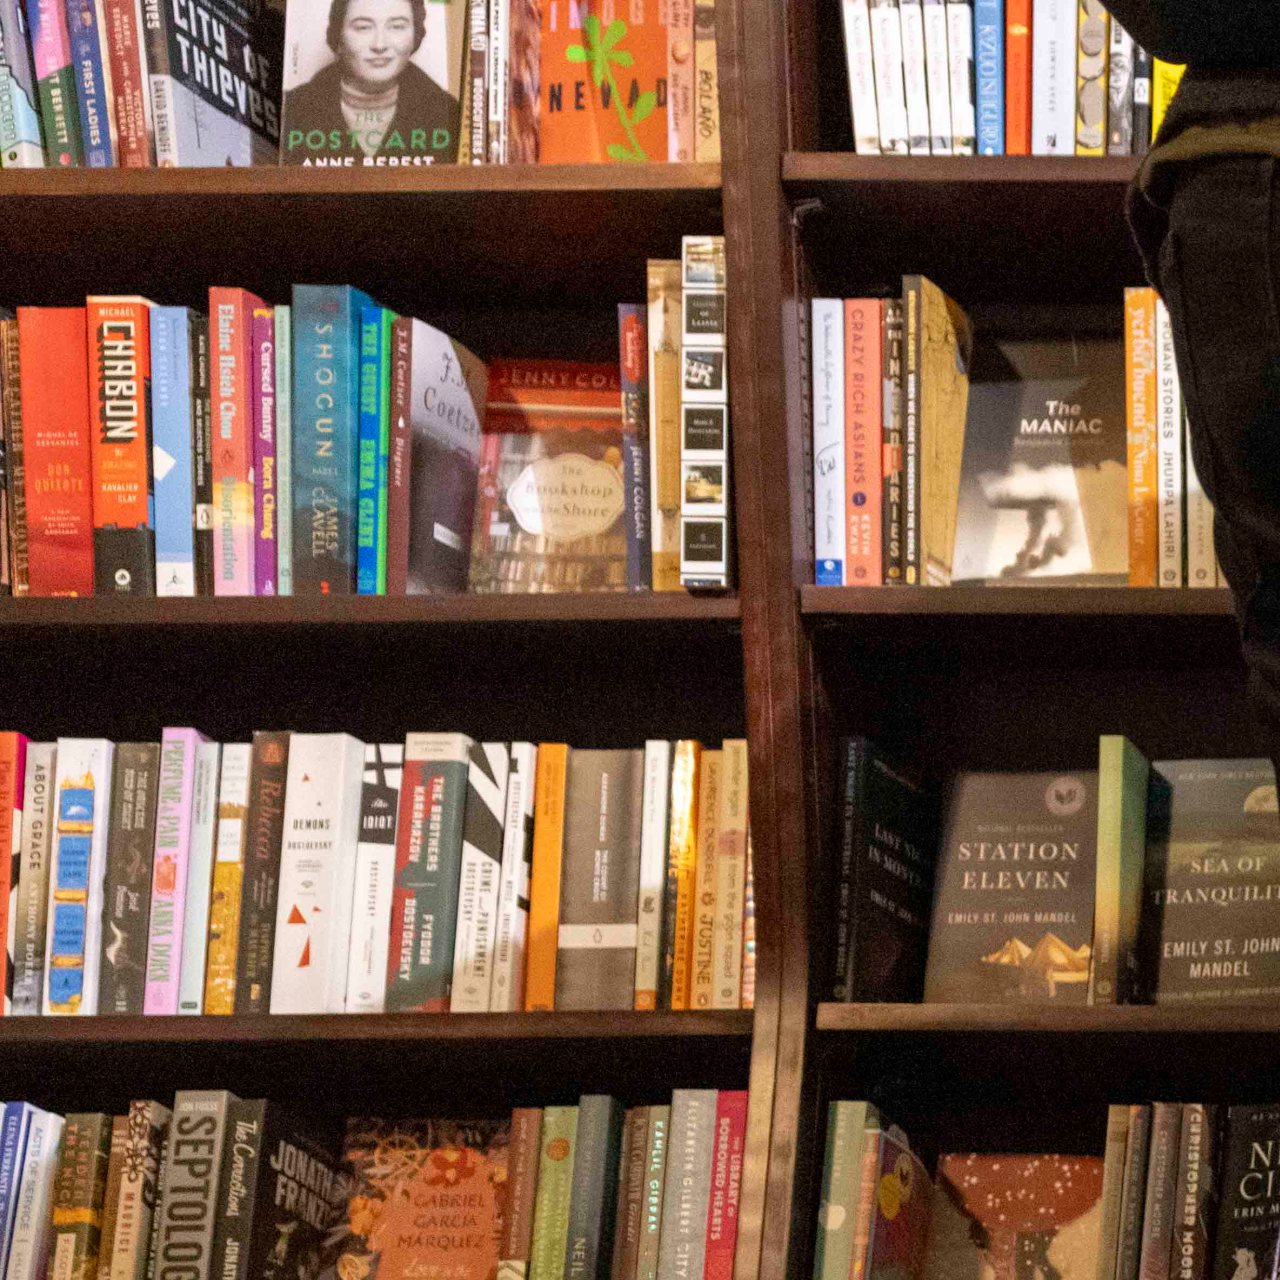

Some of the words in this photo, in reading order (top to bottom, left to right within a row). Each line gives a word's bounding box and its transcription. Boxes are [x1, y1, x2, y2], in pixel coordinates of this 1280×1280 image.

[81, 60, 95, 97] FIRST
[85, 99, 100, 146] LADIES
[287, 129, 450, 150] POSTCARD
[850, 308, 865, 368] CRAZY
[101, 321, 138, 440] CHABON
[259, 341, 274, 393] Cursed
[851, 373, 866, 409] RICH
[1046, 400, 1082, 417] The
[259, 395, 275, 443] Bunny
[1020, 417, 1103, 435] MANIAC
[261, 456, 274, 490] Bora
[852, 413, 867, 486] ASIANS
[260, 492, 275, 540] Chung
[433, 776, 444, 801] THE
[293, 817, 331, 831] DEMONS
[362, 815, 394, 831] IDIOT
[426, 804, 443, 872] BROTHERS
[958, 842, 1079, 862] STATION
[963, 871, 1070, 890] ELEVEN
[399, 897, 416, 982] DOSTOEVSKY
[419, 914, 434, 966] FYODOR
[1189, 958, 1251, 979] MANDEL
[650, 1120, 664, 1173] KAHLIL
[714, 1117, 731, 1188] BORROWED
[727, 1154, 741, 1206] LIBRARY
[709, 1190, 725, 1241] HEARTS
[570, 1237, 586, 1279] NEIL
